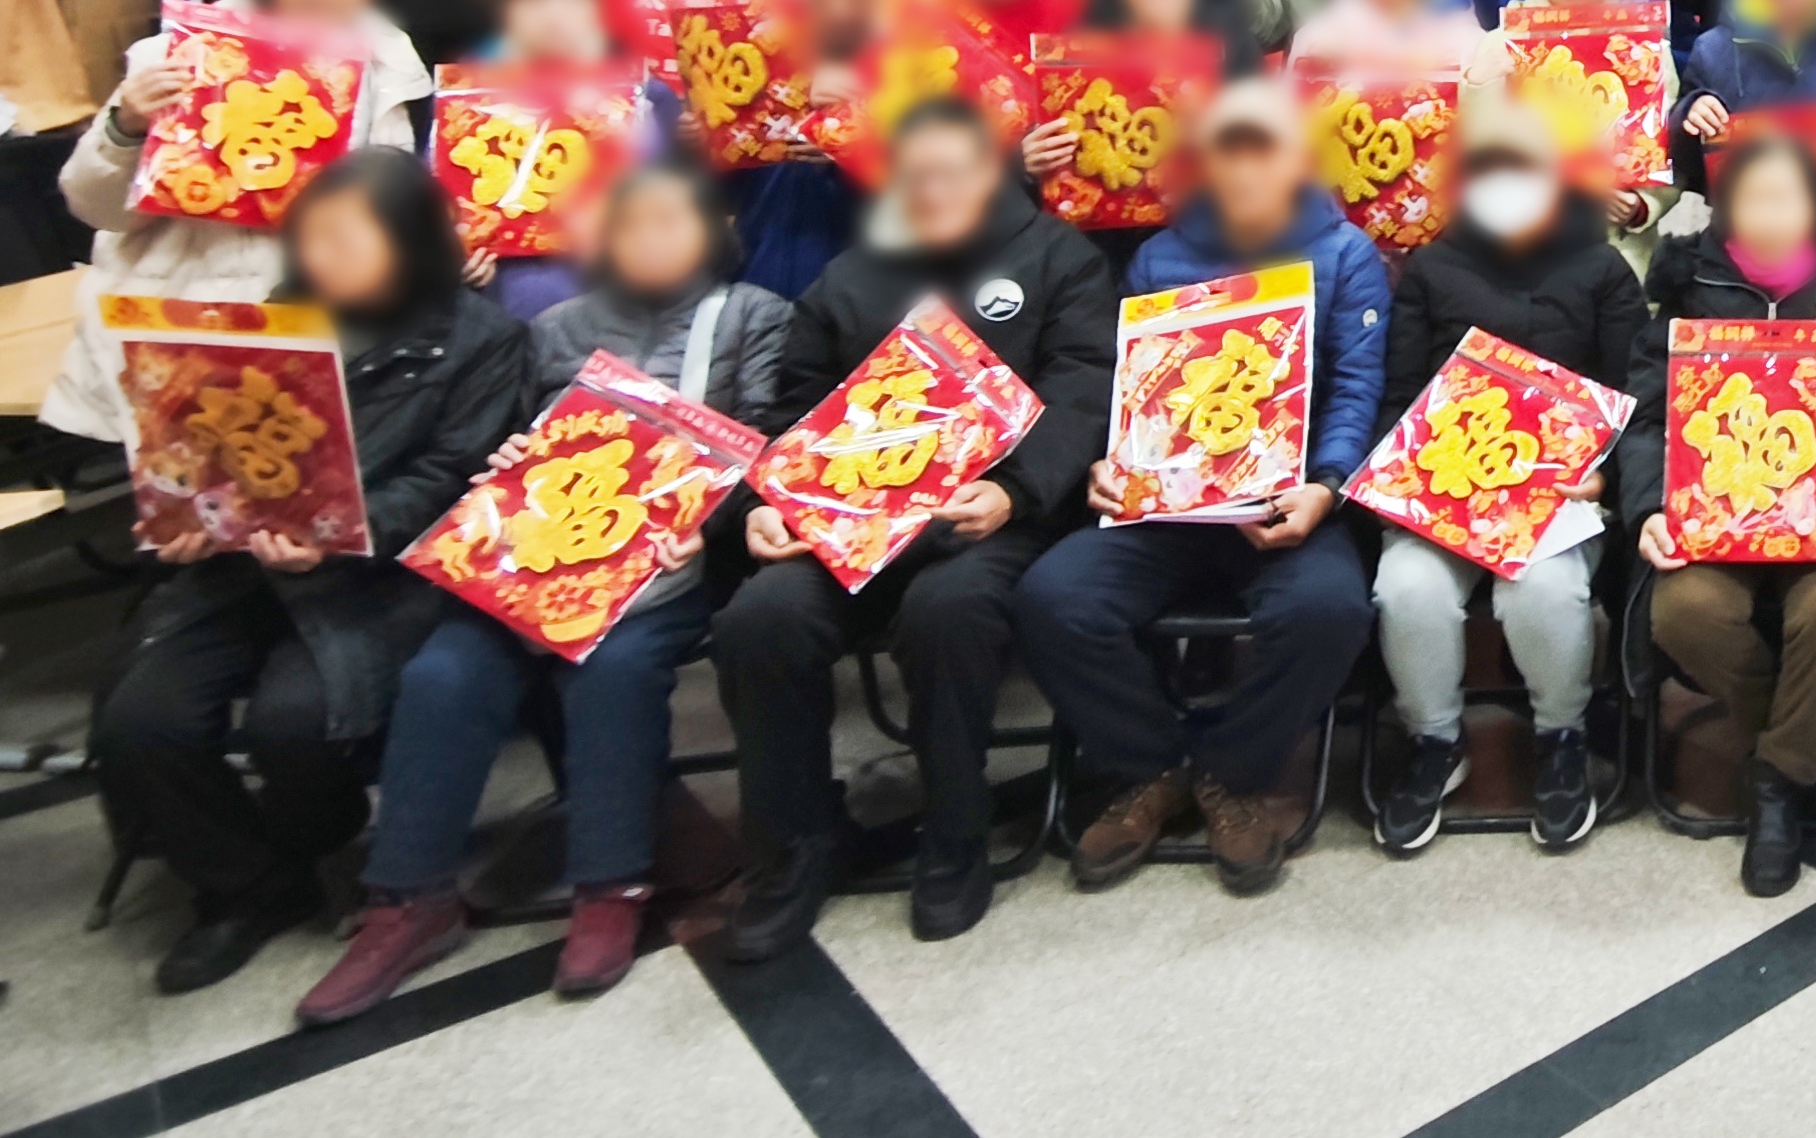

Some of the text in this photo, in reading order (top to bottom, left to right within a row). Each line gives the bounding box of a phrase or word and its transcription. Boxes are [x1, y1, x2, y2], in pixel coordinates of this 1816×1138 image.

[201, 69, 338, 190] 福
[450, 115, 590, 217] 福
[186, 365, 328, 498] 福
[1166, 328, 1291, 456] 福
[1417, 387, 1540, 499] 福
[510, 438, 648, 573] 福
